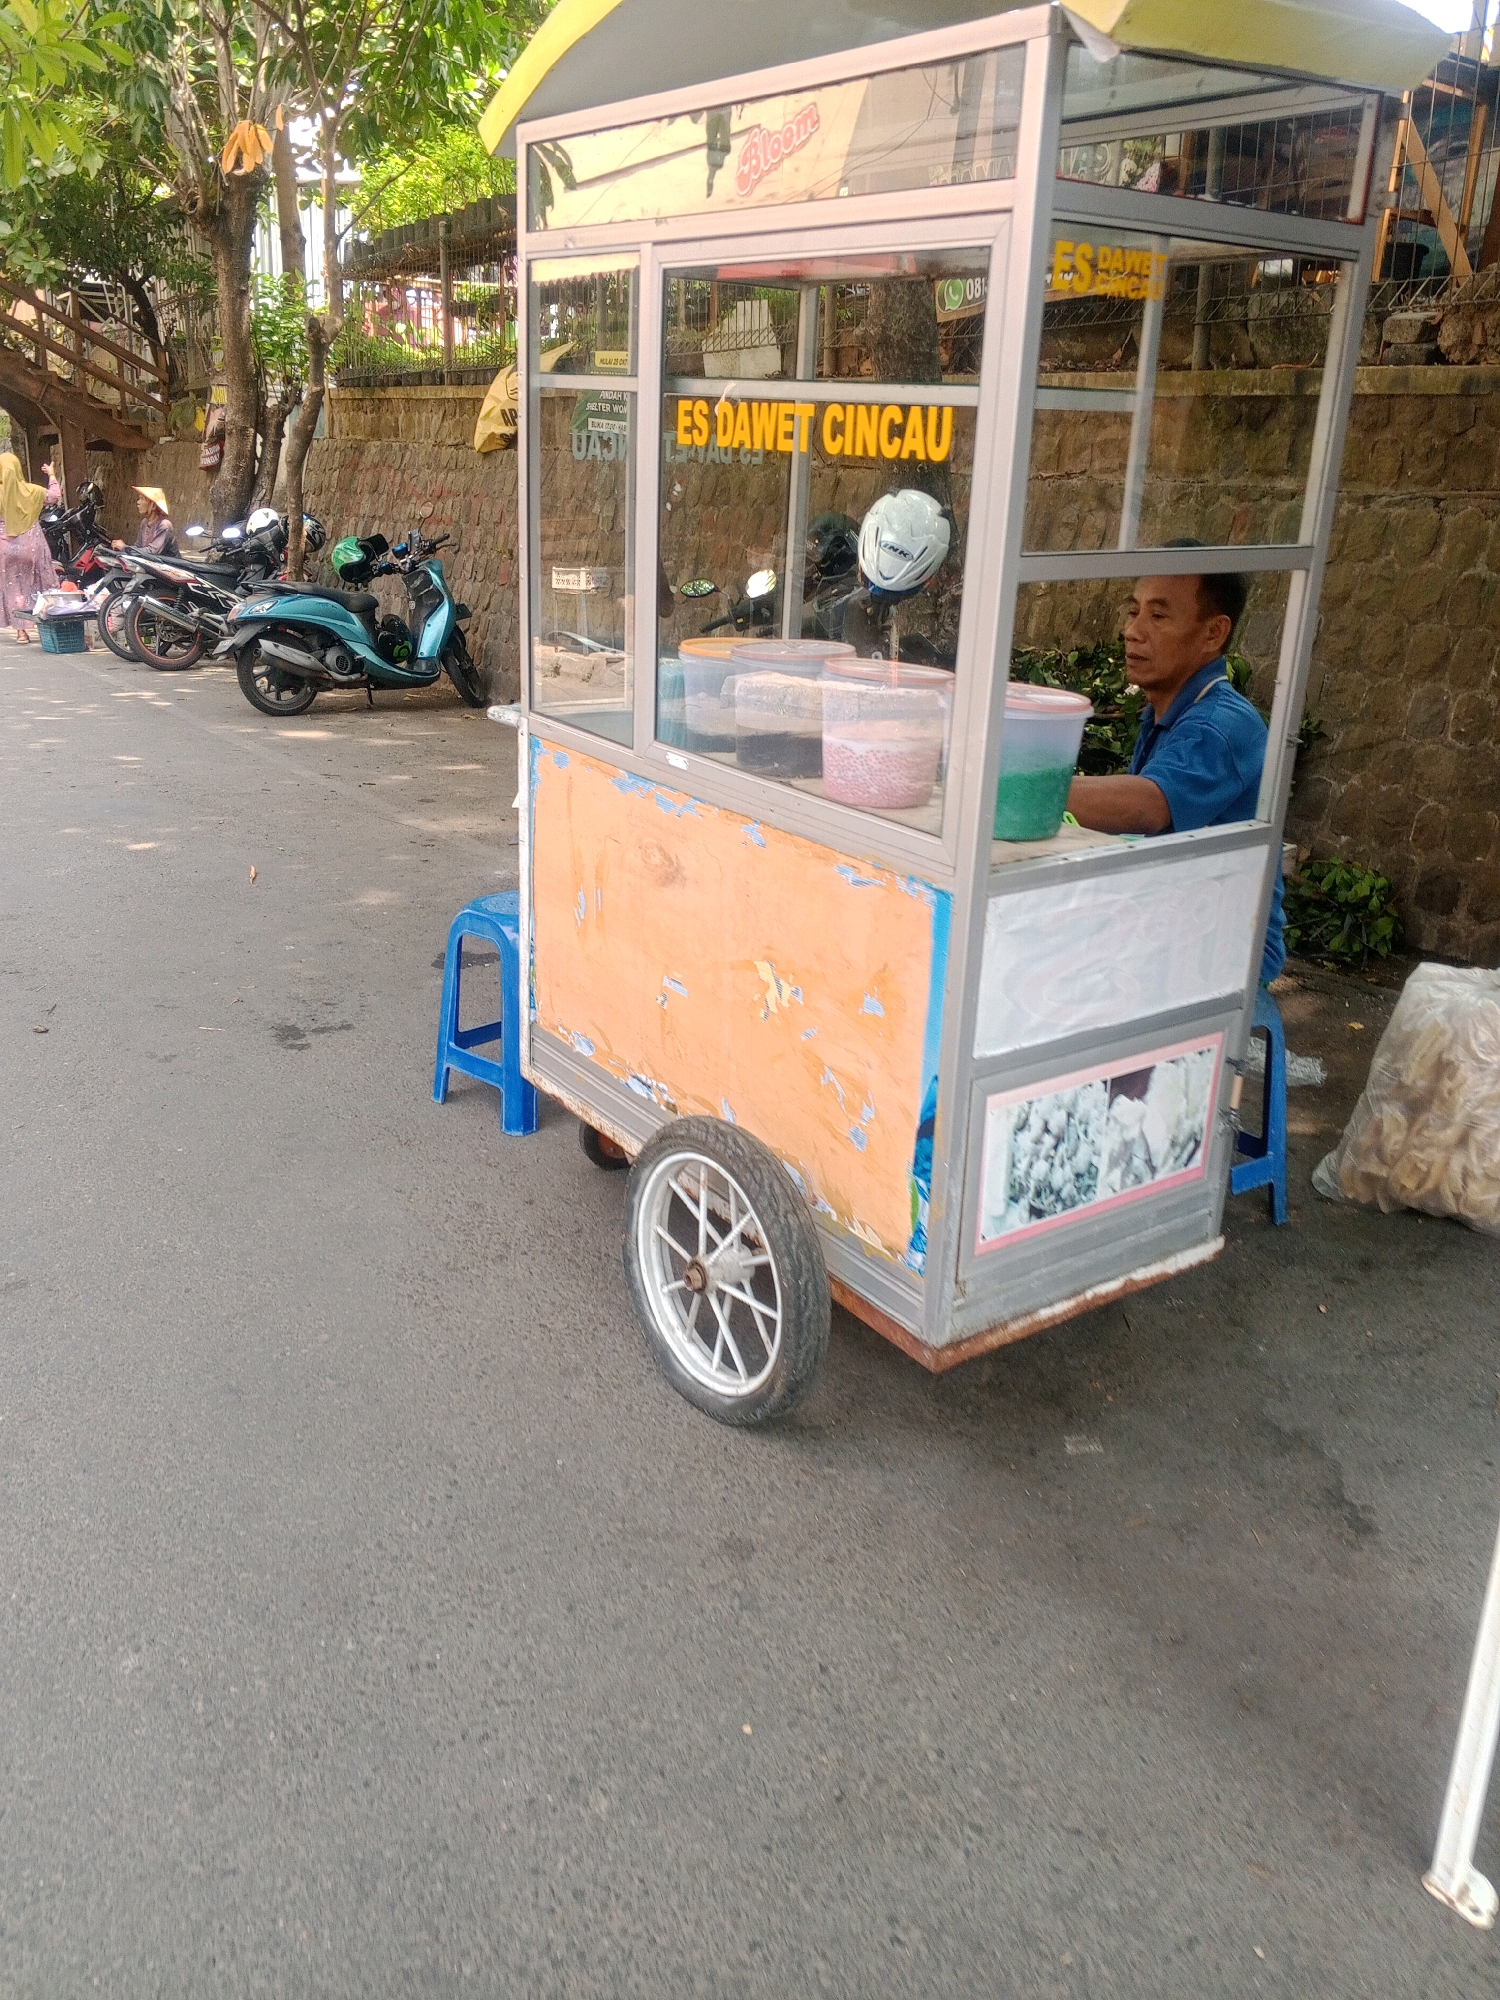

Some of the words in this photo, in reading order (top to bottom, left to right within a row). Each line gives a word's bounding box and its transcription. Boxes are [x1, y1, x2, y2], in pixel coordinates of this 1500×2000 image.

[736, 103, 820, 197] Bloom
[1053, 241, 1093, 293] ES
[1097, 246, 1167, 277] DAWET
[1096, 272, 1164, 302] CINCAU
[585, 402, 611, 413] SHELTER
[677, 400, 709, 447] ES
[717, 401, 815, 453] DAWET
[823, 403, 953, 462] CINCAU
[883, 542, 910, 558] INK
